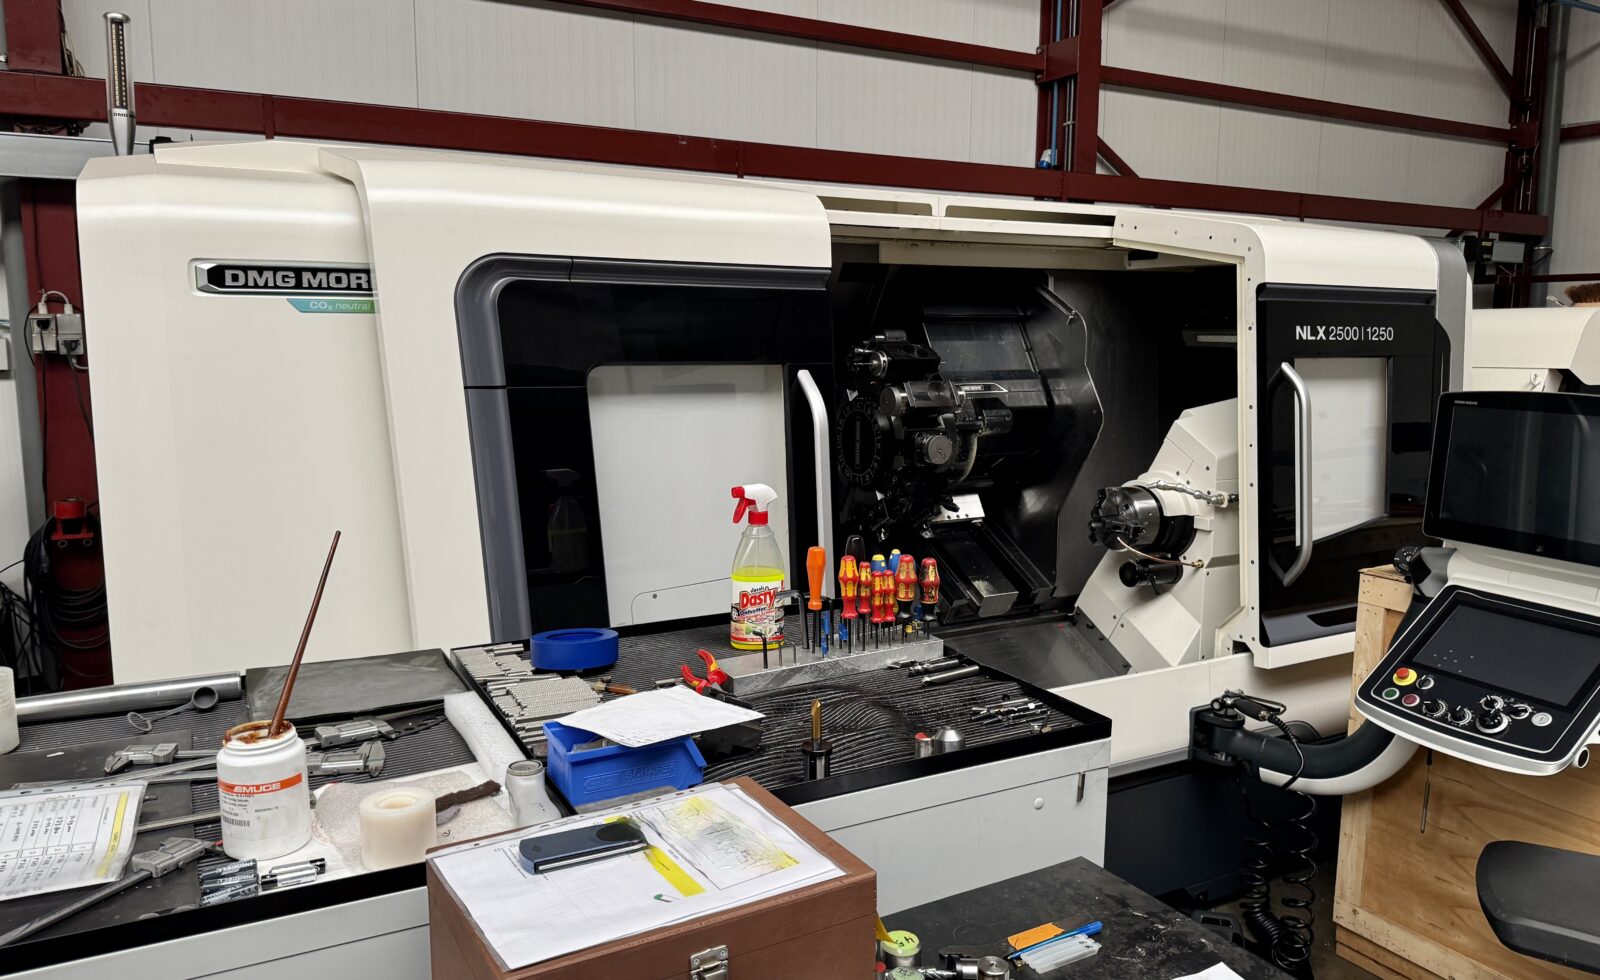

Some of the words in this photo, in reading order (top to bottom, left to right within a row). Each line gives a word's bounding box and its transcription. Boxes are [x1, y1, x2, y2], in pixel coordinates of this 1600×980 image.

[224, 269, 296, 287] DMG
[301, 271, 372, 289] MOR
[335, 302, 371, 310] neutral
[1295, 325, 1326, 340] NLX
[740, 590, 776, 609] Dasty
[233, 784, 281, 793] EMUGE
